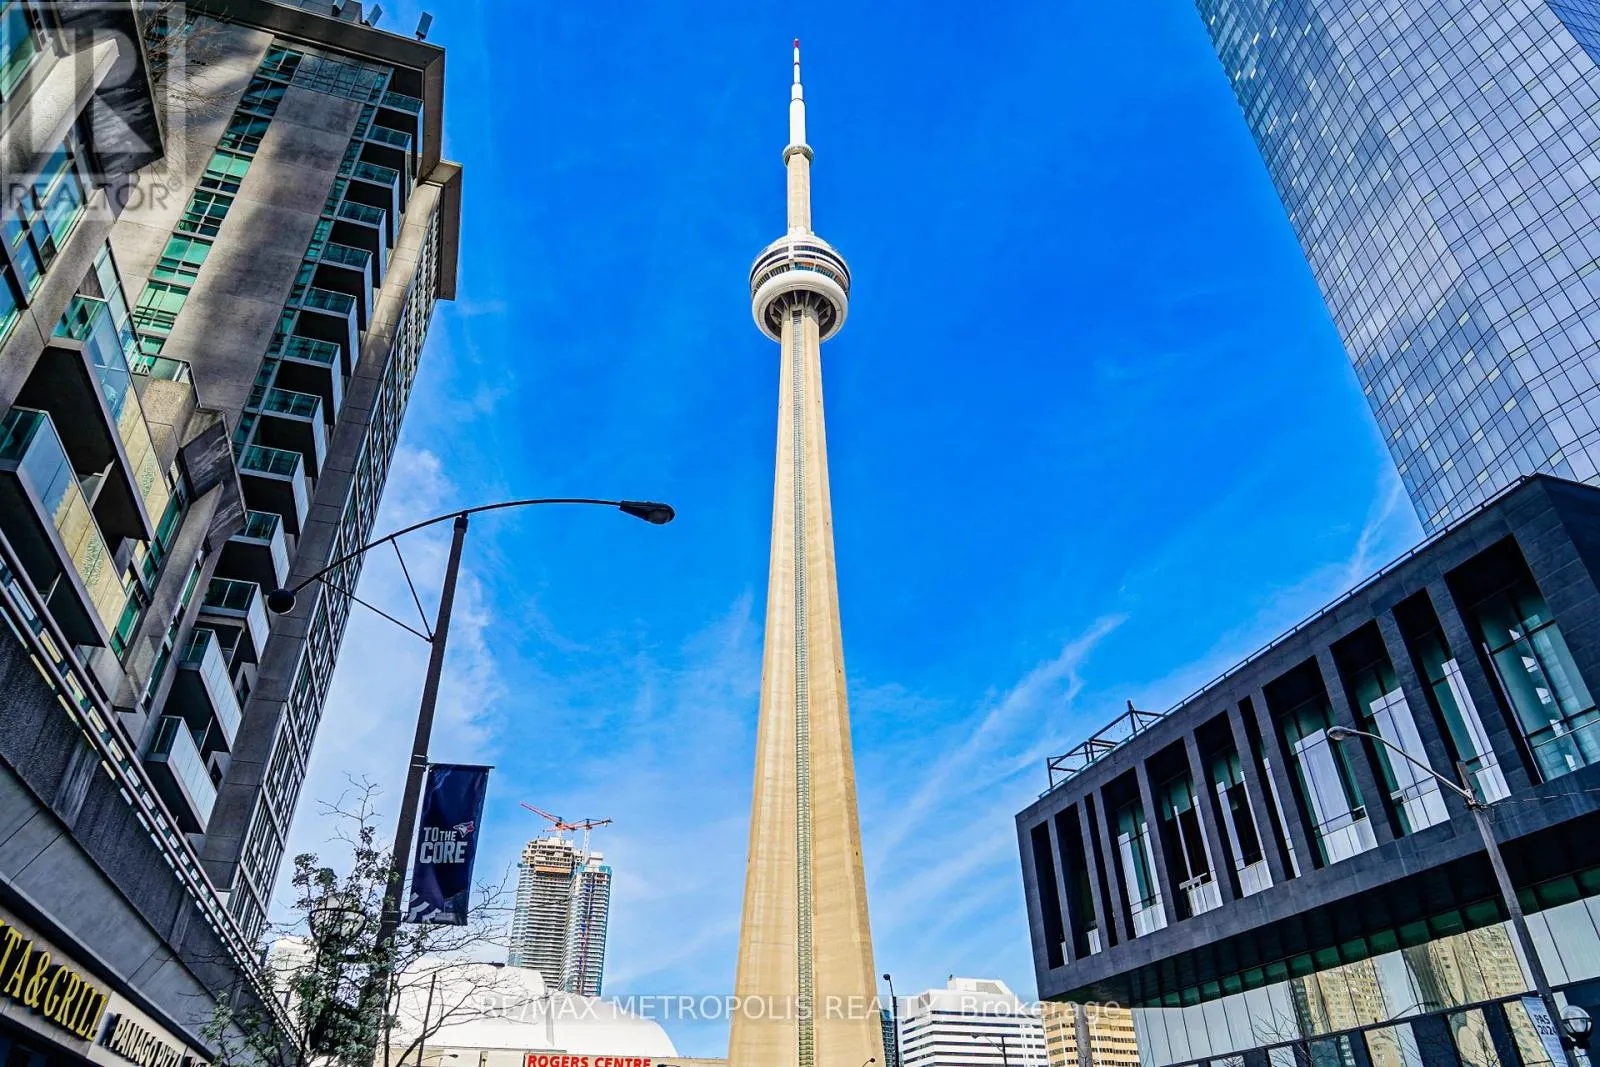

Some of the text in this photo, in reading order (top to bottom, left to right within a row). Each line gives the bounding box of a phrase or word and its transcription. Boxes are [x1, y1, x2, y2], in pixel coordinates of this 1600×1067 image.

[424, 827, 457, 842] TO THE
[420, 841, 467, 863] CORE
[109, 1018, 157, 1067] PANAGO
[527, 1055, 651, 1067] ROGERS CENTRE
